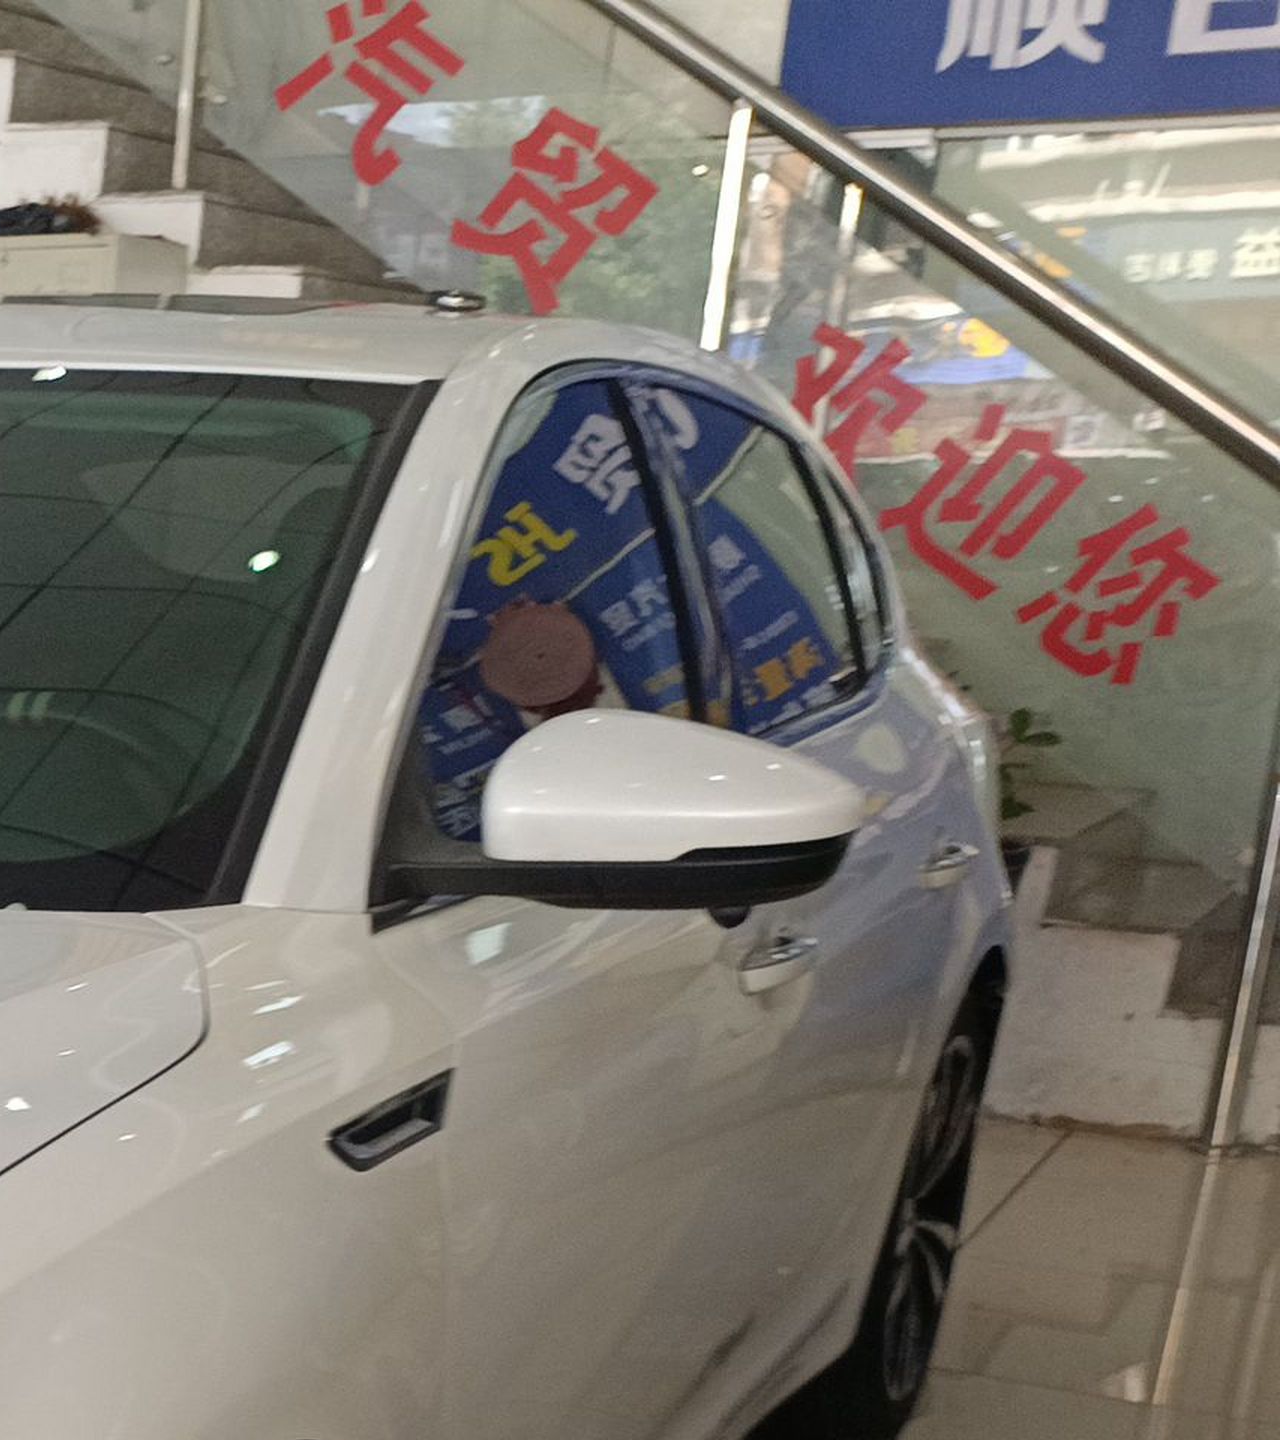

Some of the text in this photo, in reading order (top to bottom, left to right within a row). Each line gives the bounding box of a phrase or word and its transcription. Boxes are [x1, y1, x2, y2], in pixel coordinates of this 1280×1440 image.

[274, 0, 1222, 687] 汽贸 欢迎您
